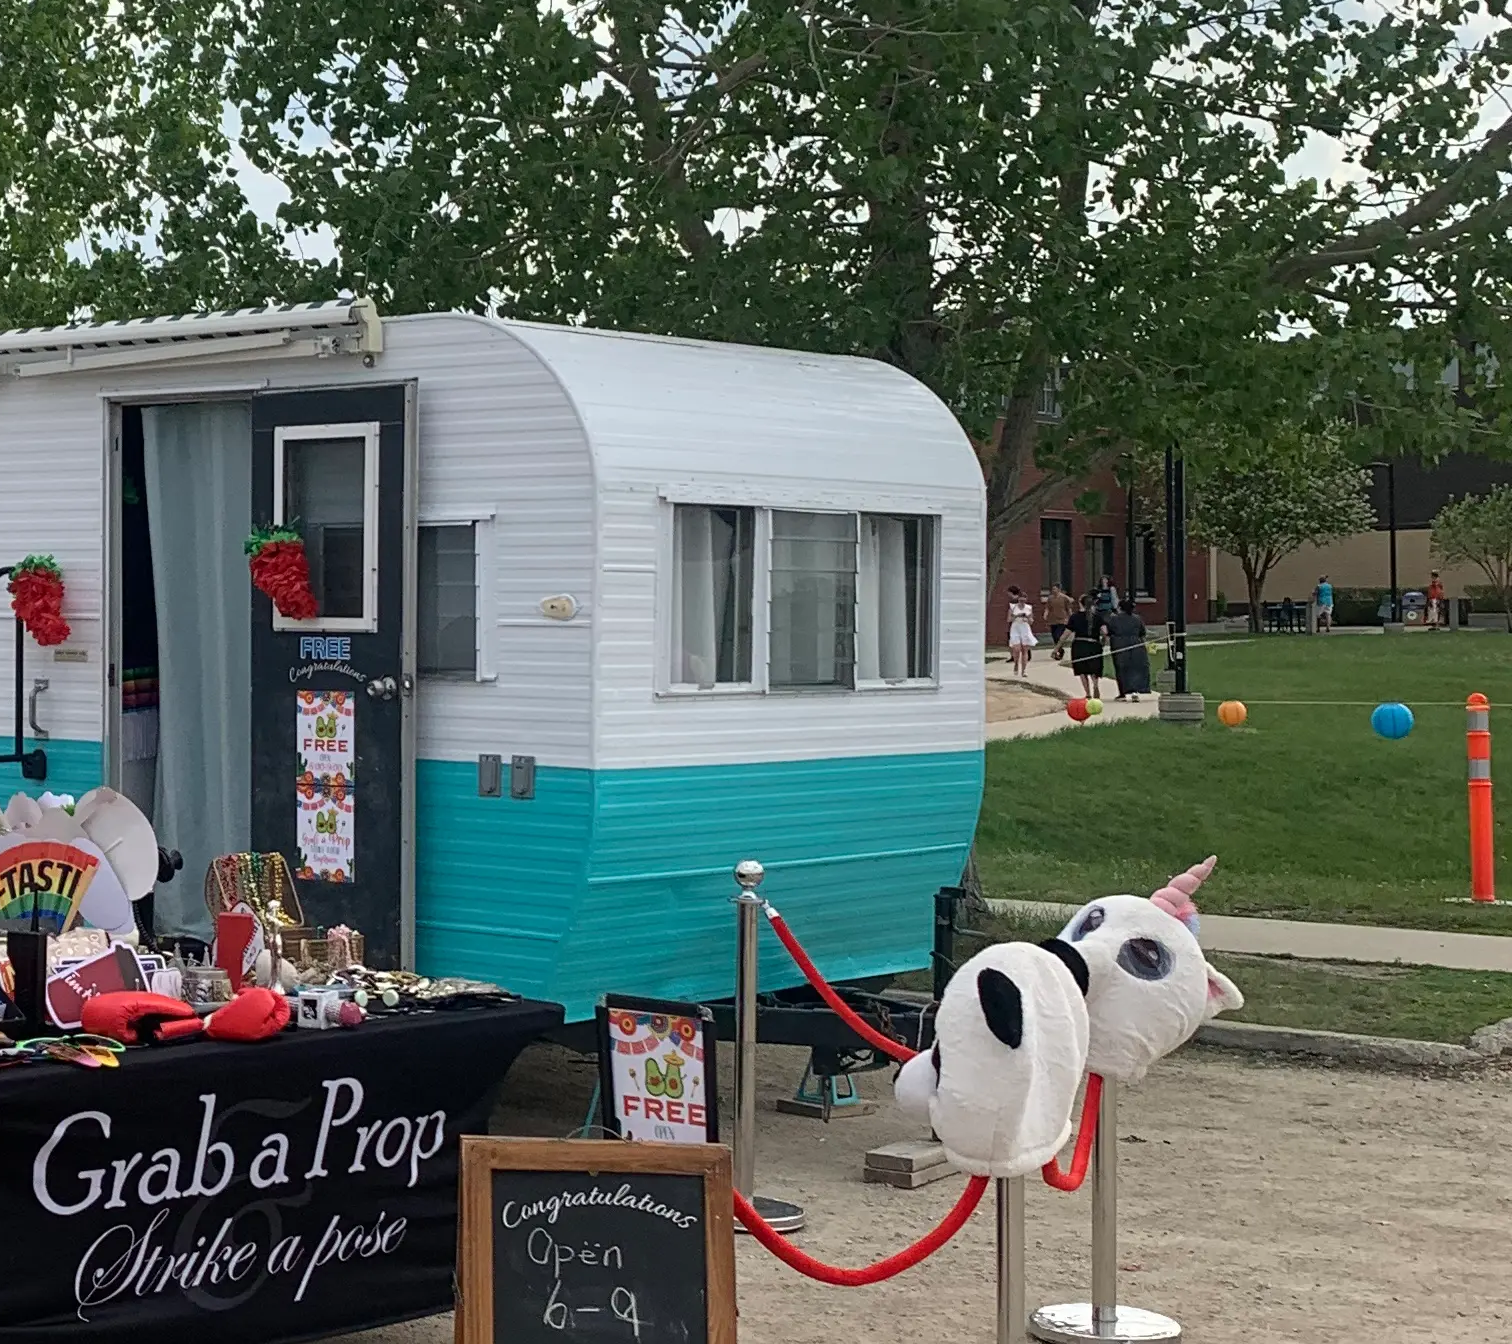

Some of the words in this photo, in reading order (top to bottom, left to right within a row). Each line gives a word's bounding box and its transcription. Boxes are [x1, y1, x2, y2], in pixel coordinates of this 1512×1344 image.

[300, 637, 351, 660] FREE
[289, 660, 367, 683] Congratulations
[303, 739, 348, 752] FREE
[623, 1095, 706, 1126] FREE
[32, 1093, 234, 1215] Grab
[249, 1132, 288, 1188] a
[303, 1077, 446, 1187] Prop
[502, 1184, 698, 1229] Congratulations
[74, 1207, 257, 1323] Strike
[267, 1234, 304, 1276] a
[293, 1210, 408, 1302] pose
